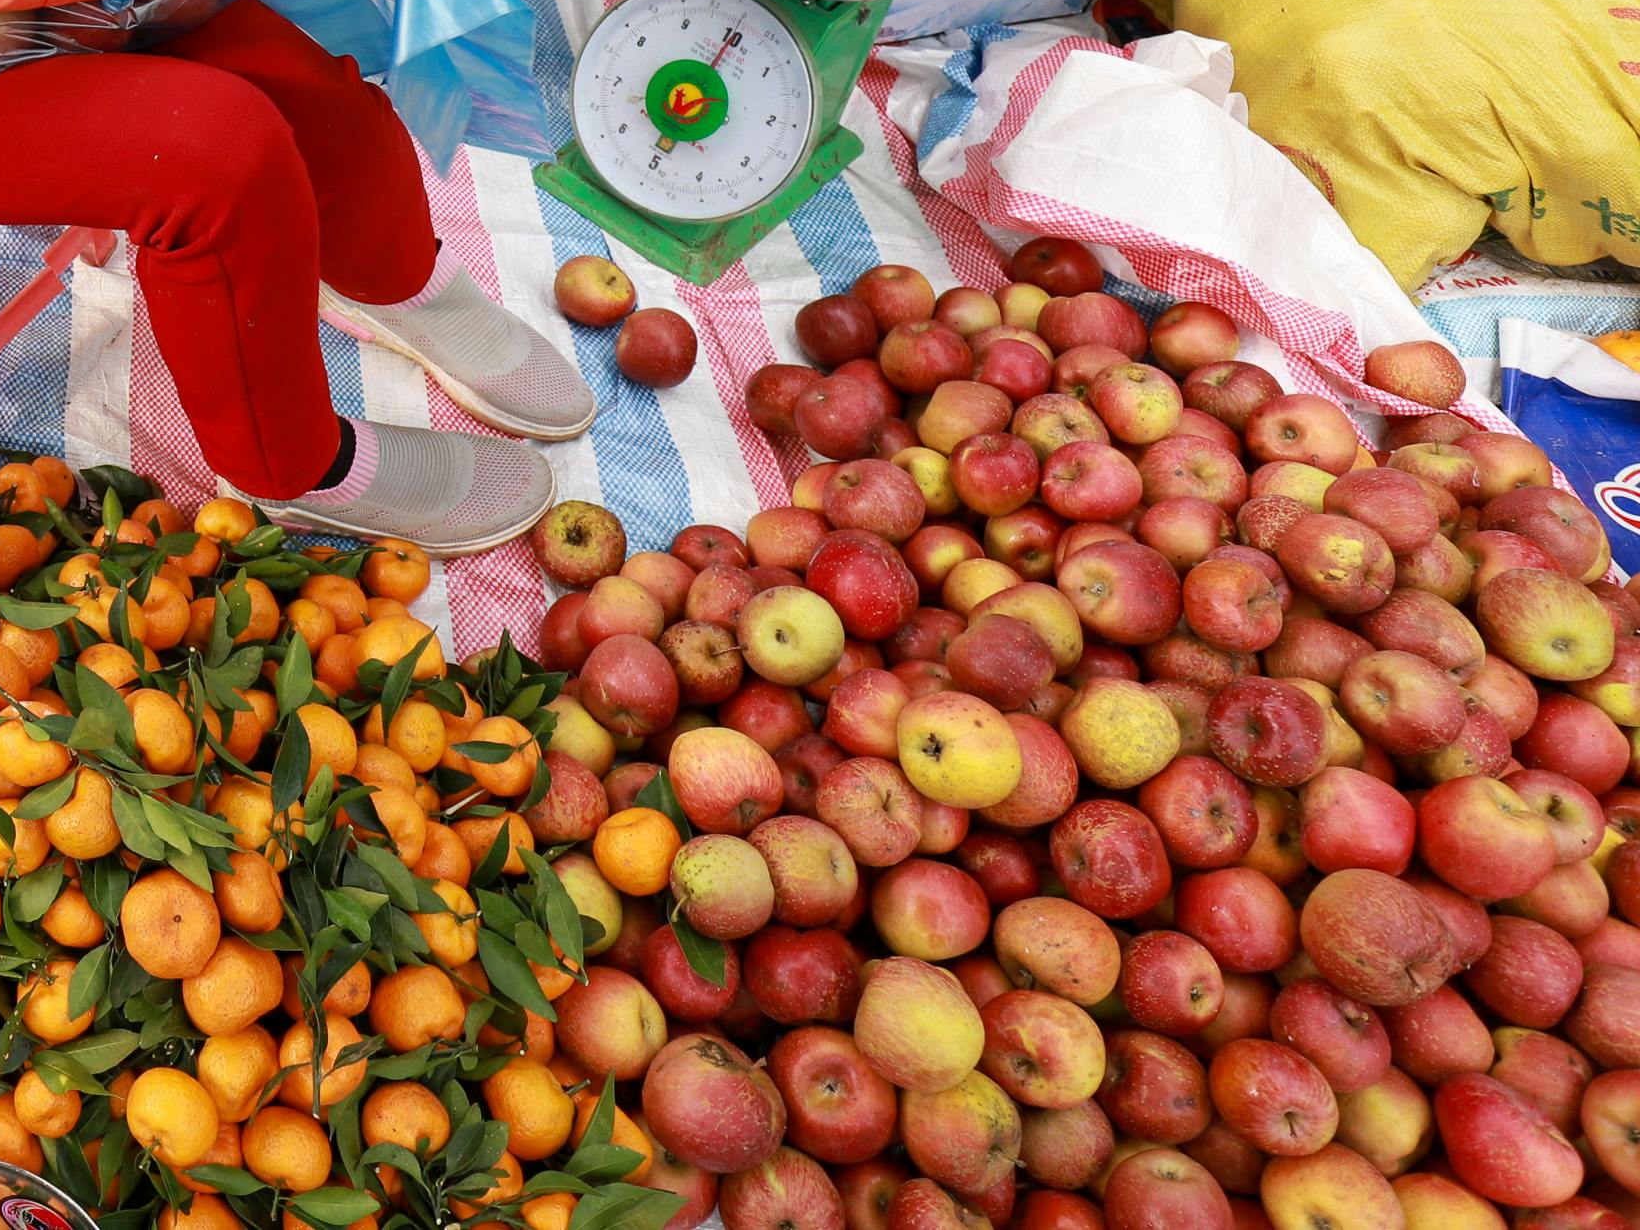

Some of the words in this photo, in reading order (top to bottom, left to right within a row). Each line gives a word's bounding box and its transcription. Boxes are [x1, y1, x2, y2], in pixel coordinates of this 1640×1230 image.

[680, 18, 691, 30] 9
[636, 36, 647, 48] 8
[722, 27, 743, 48] 10
[761, 66, 771, 78] 1
[612, 76, 623, 88] 7
[765, 114, 777, 127] 2
[618, 123, 628, 135] 6
[648, 154, 663, 171] 5
[740, 155, 751, 168] 3
[695, 171, 704, 183] 4
